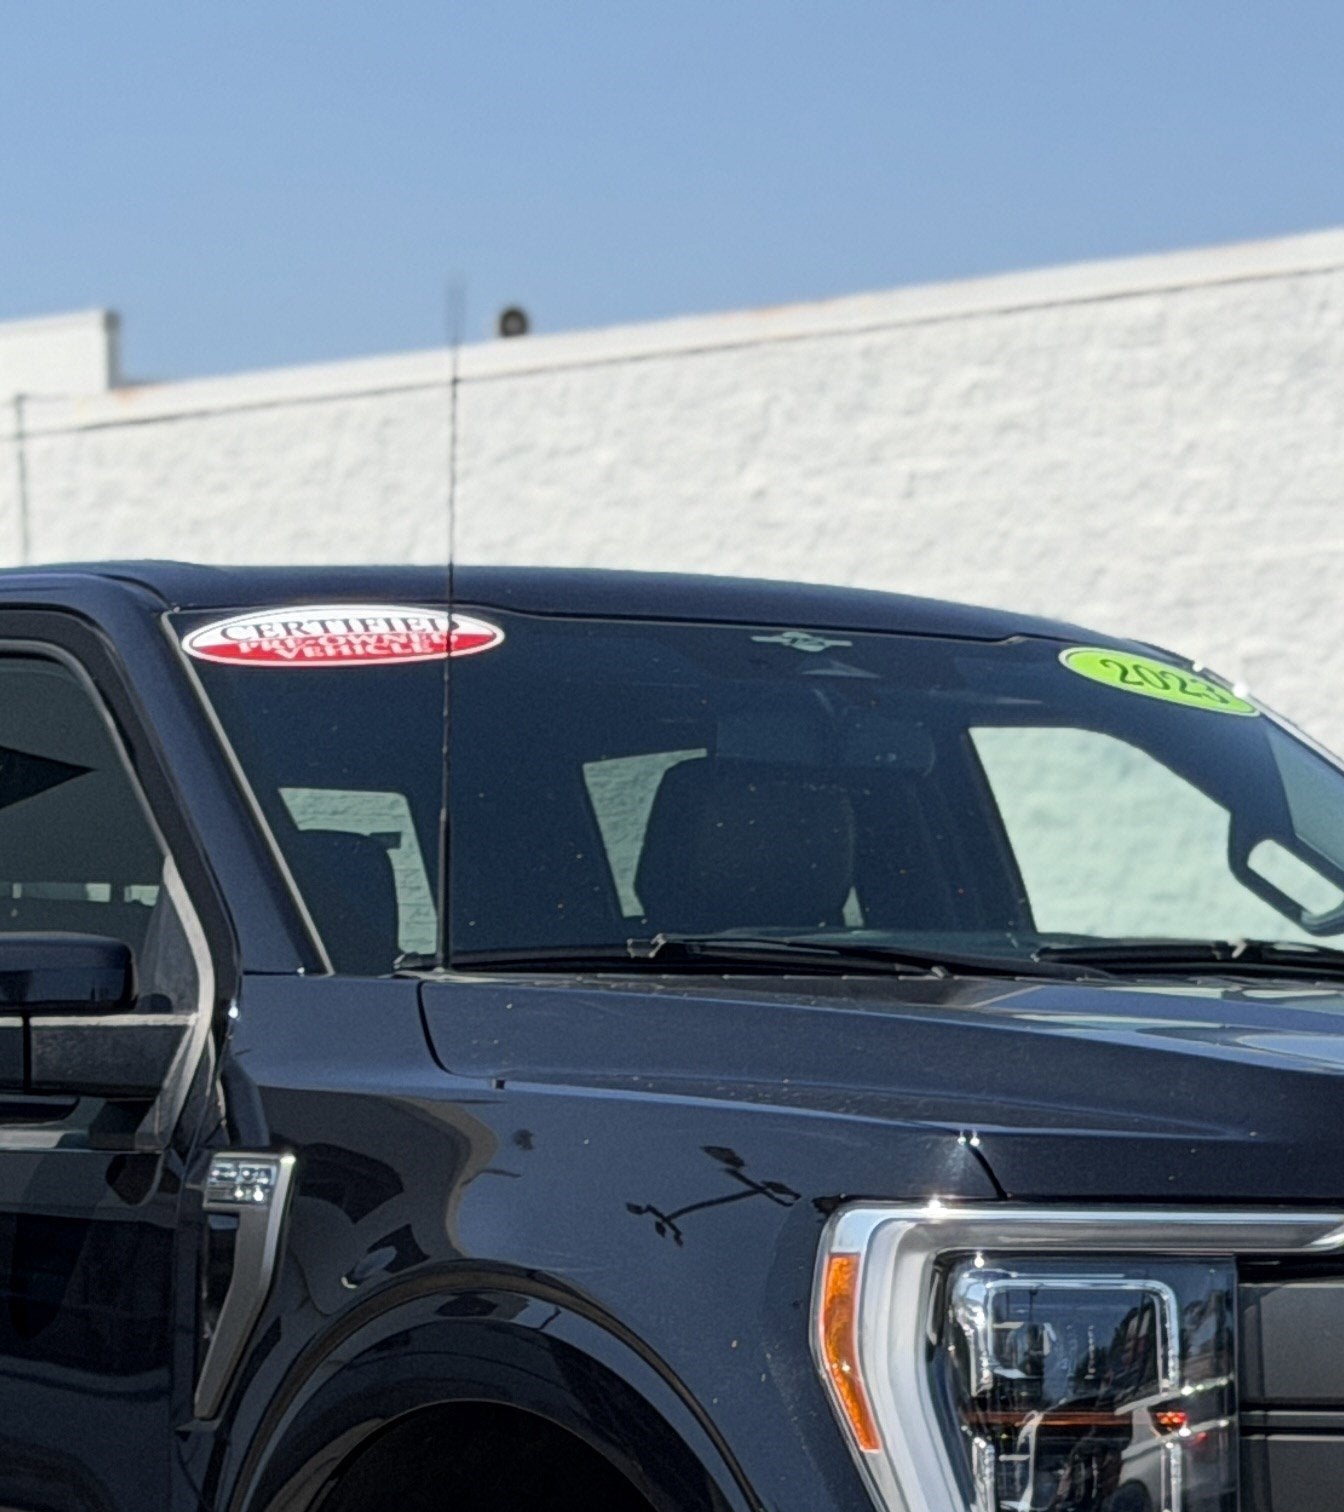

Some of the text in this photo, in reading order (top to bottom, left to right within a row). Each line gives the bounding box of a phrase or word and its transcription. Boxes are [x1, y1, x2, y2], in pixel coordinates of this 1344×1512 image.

[220, 616, 460, 641] CERTIFIED
[237, 632, 459, 654] PRE-OWNED
[275, 639, 434, 660] VEHICLE
